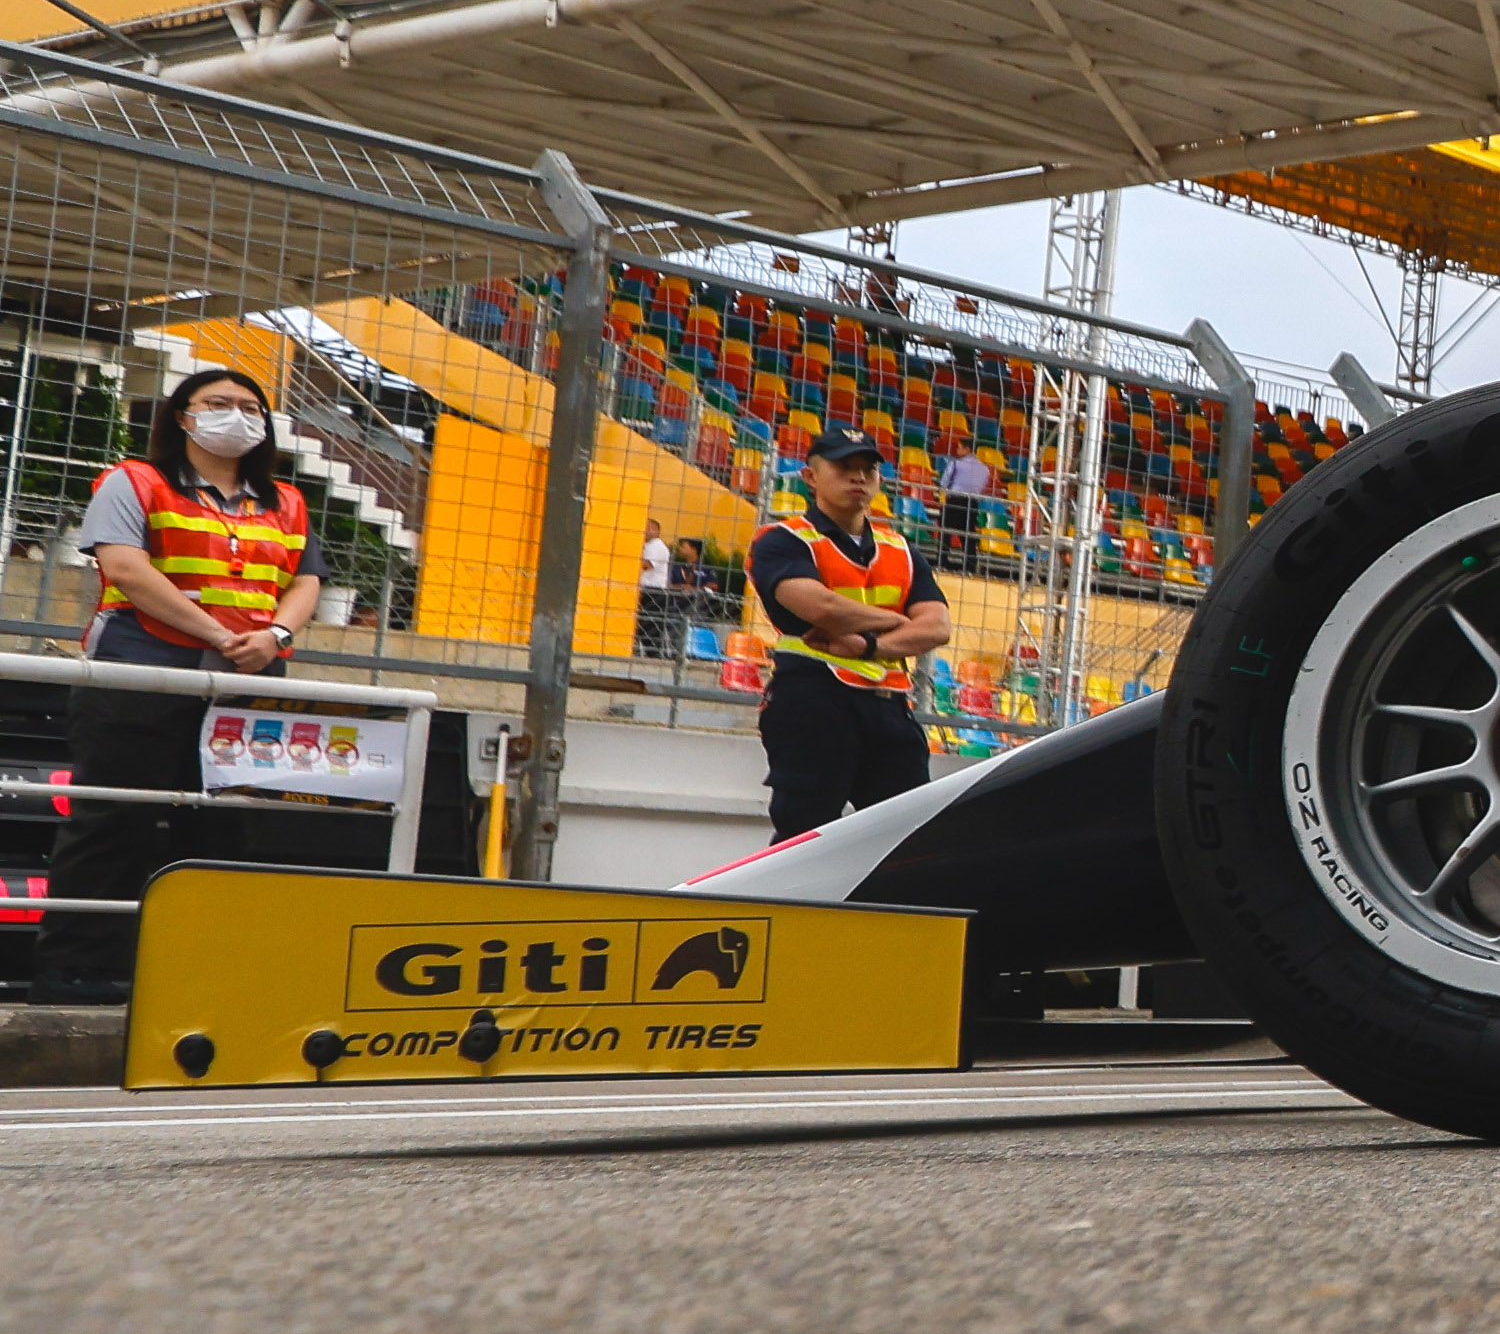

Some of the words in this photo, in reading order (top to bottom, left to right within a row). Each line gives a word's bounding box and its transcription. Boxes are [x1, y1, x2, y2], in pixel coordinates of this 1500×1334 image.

[1311, 833, 1391, 934] RACING
[375, 937, 610, 995] Giti
[341, 1024, 621, 1058] COMPITION
[643, 1022, 763, 1050] TIRES
